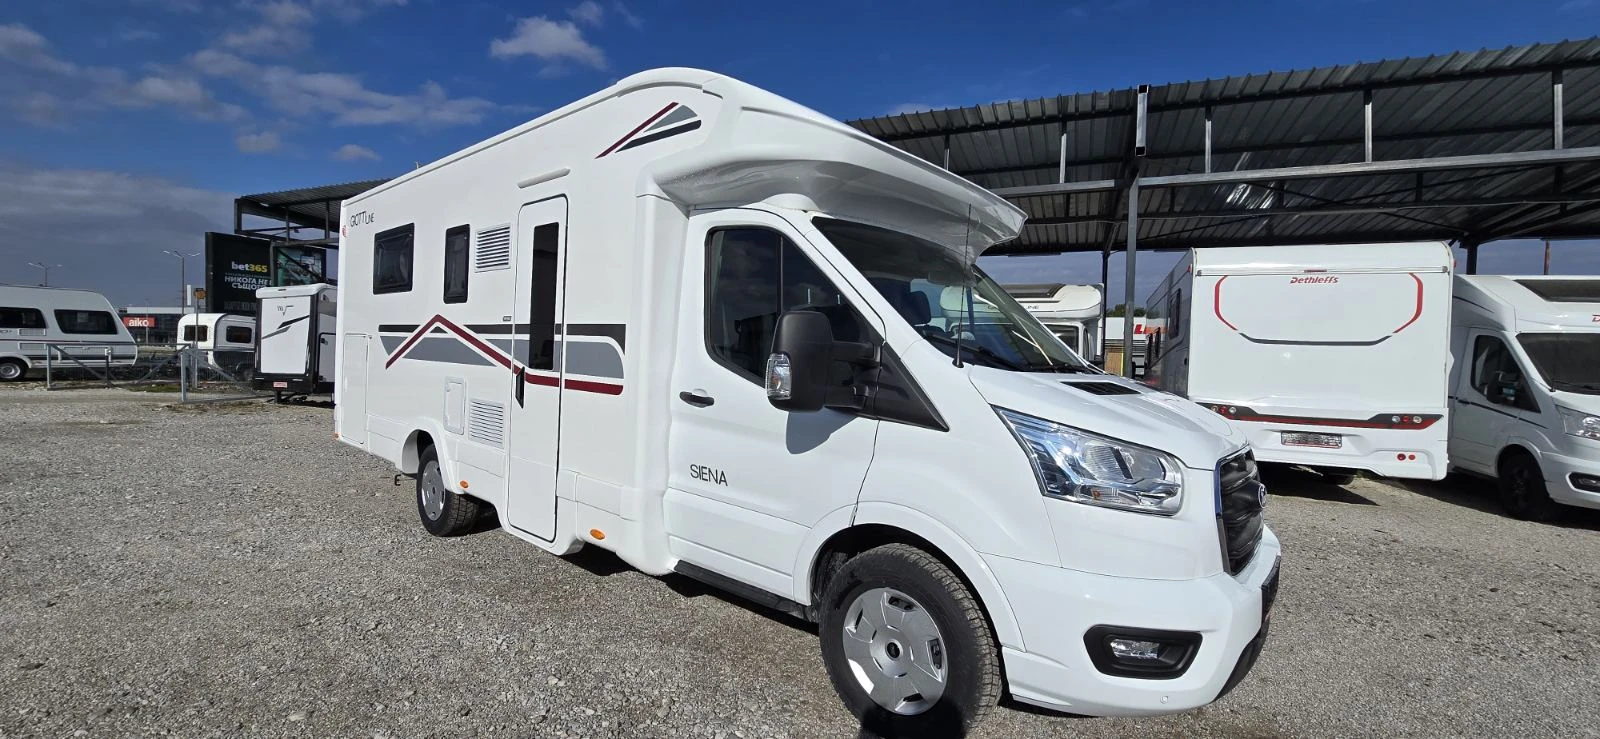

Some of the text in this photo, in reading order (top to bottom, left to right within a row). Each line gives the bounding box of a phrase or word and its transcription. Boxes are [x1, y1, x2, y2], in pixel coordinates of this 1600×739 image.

[231, 261, 268, 273] bet365
[224, 275, 257, 285] НИКОГА
[258, 278, 269, 286] НЕ
[1290, 276, 1339, 284] Dethleffs
[128, 317, 149, 327] aiko
[690, 464, 728, 487] SIENA
